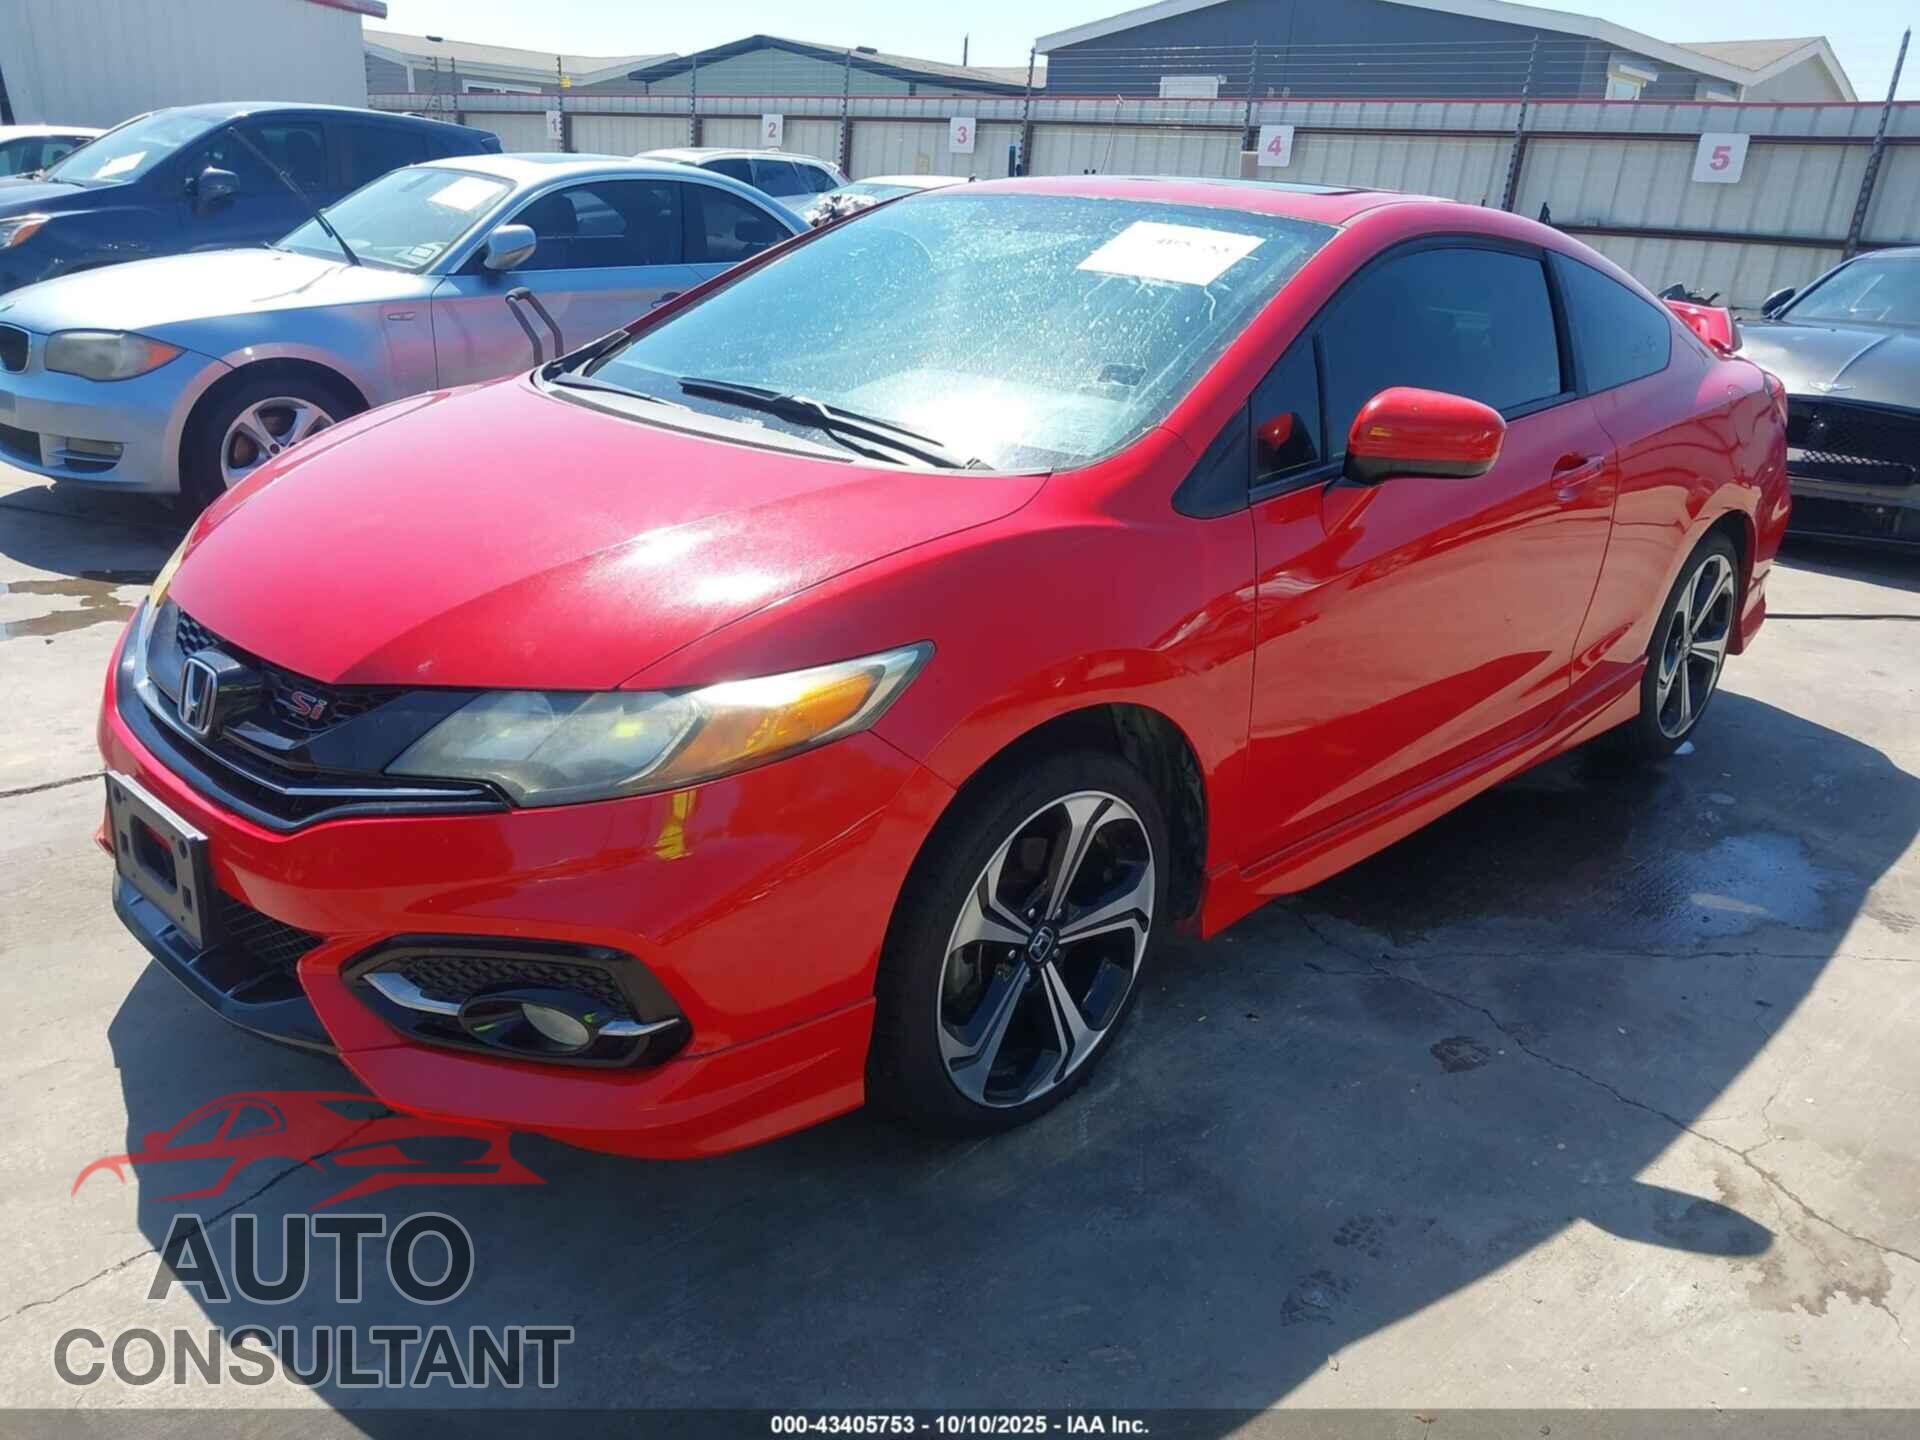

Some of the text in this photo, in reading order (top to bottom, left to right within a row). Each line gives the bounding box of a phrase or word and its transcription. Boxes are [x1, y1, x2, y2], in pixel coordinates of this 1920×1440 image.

[768, 121, 777, 138] 2
[957, 126, 967, 144] 3
[1267, 135, 1282, 157] 4
[1710, 145, 1731, 170] 5
[291, 690, 328, 720] Si
